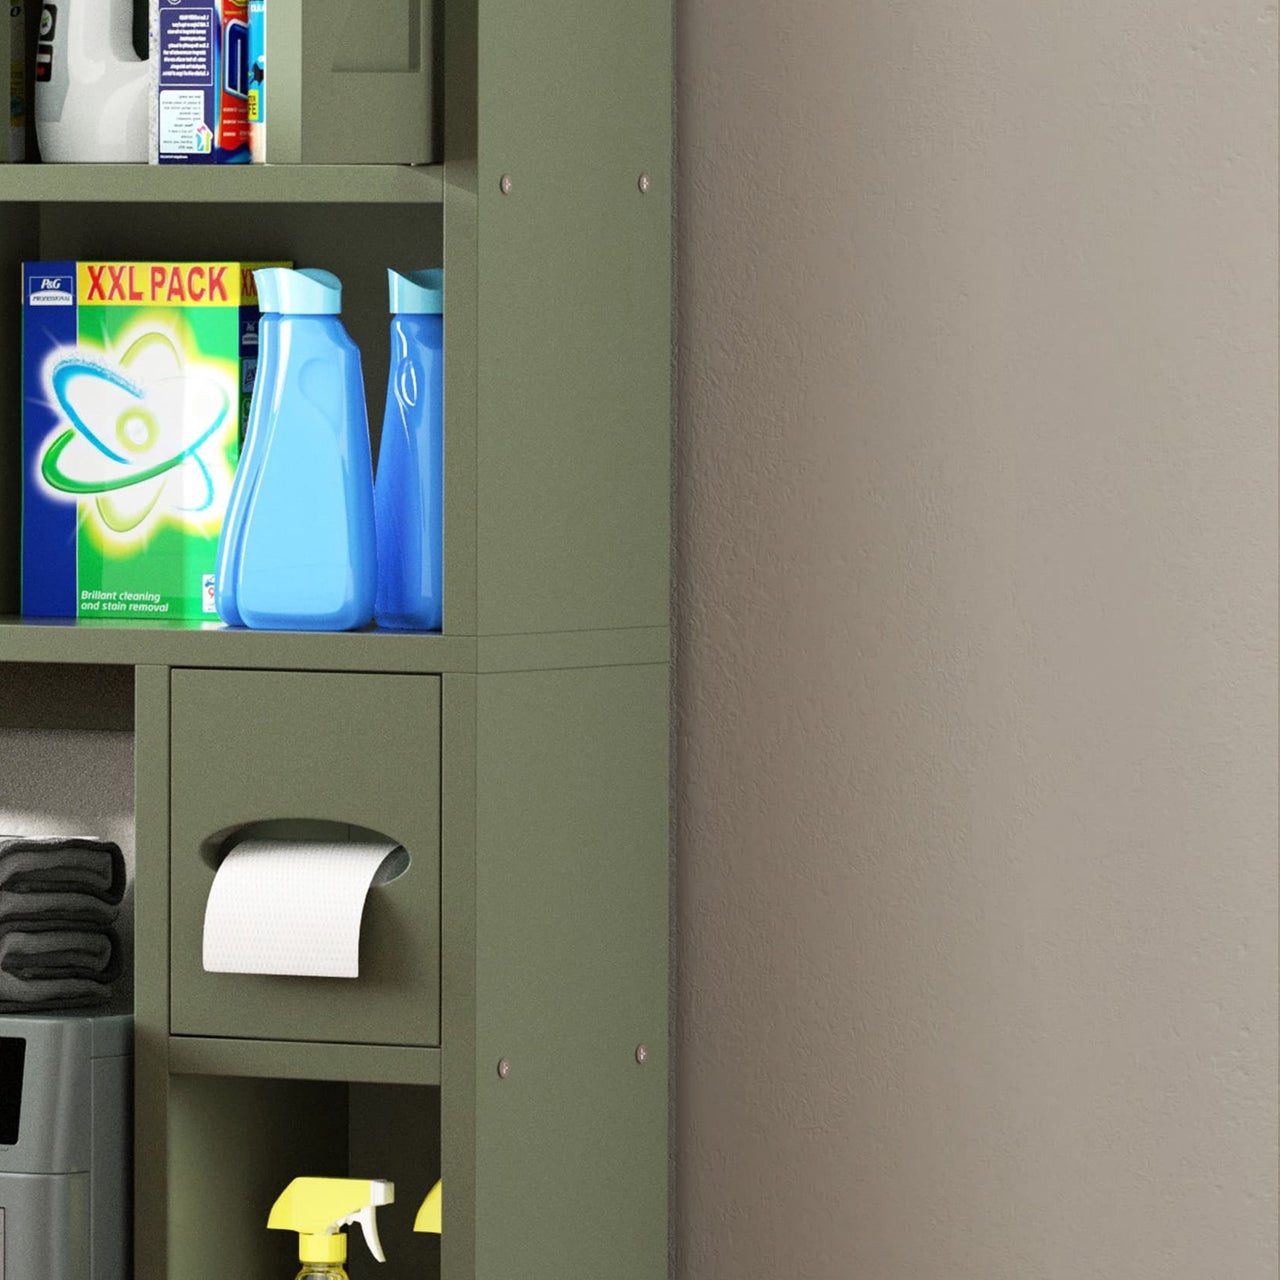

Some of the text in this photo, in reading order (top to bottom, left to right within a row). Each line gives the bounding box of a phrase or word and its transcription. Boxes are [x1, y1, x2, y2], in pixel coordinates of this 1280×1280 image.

[40, 278, 62, 290] P&G
[87, 266, 228, 302] XXL PACK
[81, 590, 160, 604] Brilliant cleaning
[81, 601, 168, 612] and stain removal
